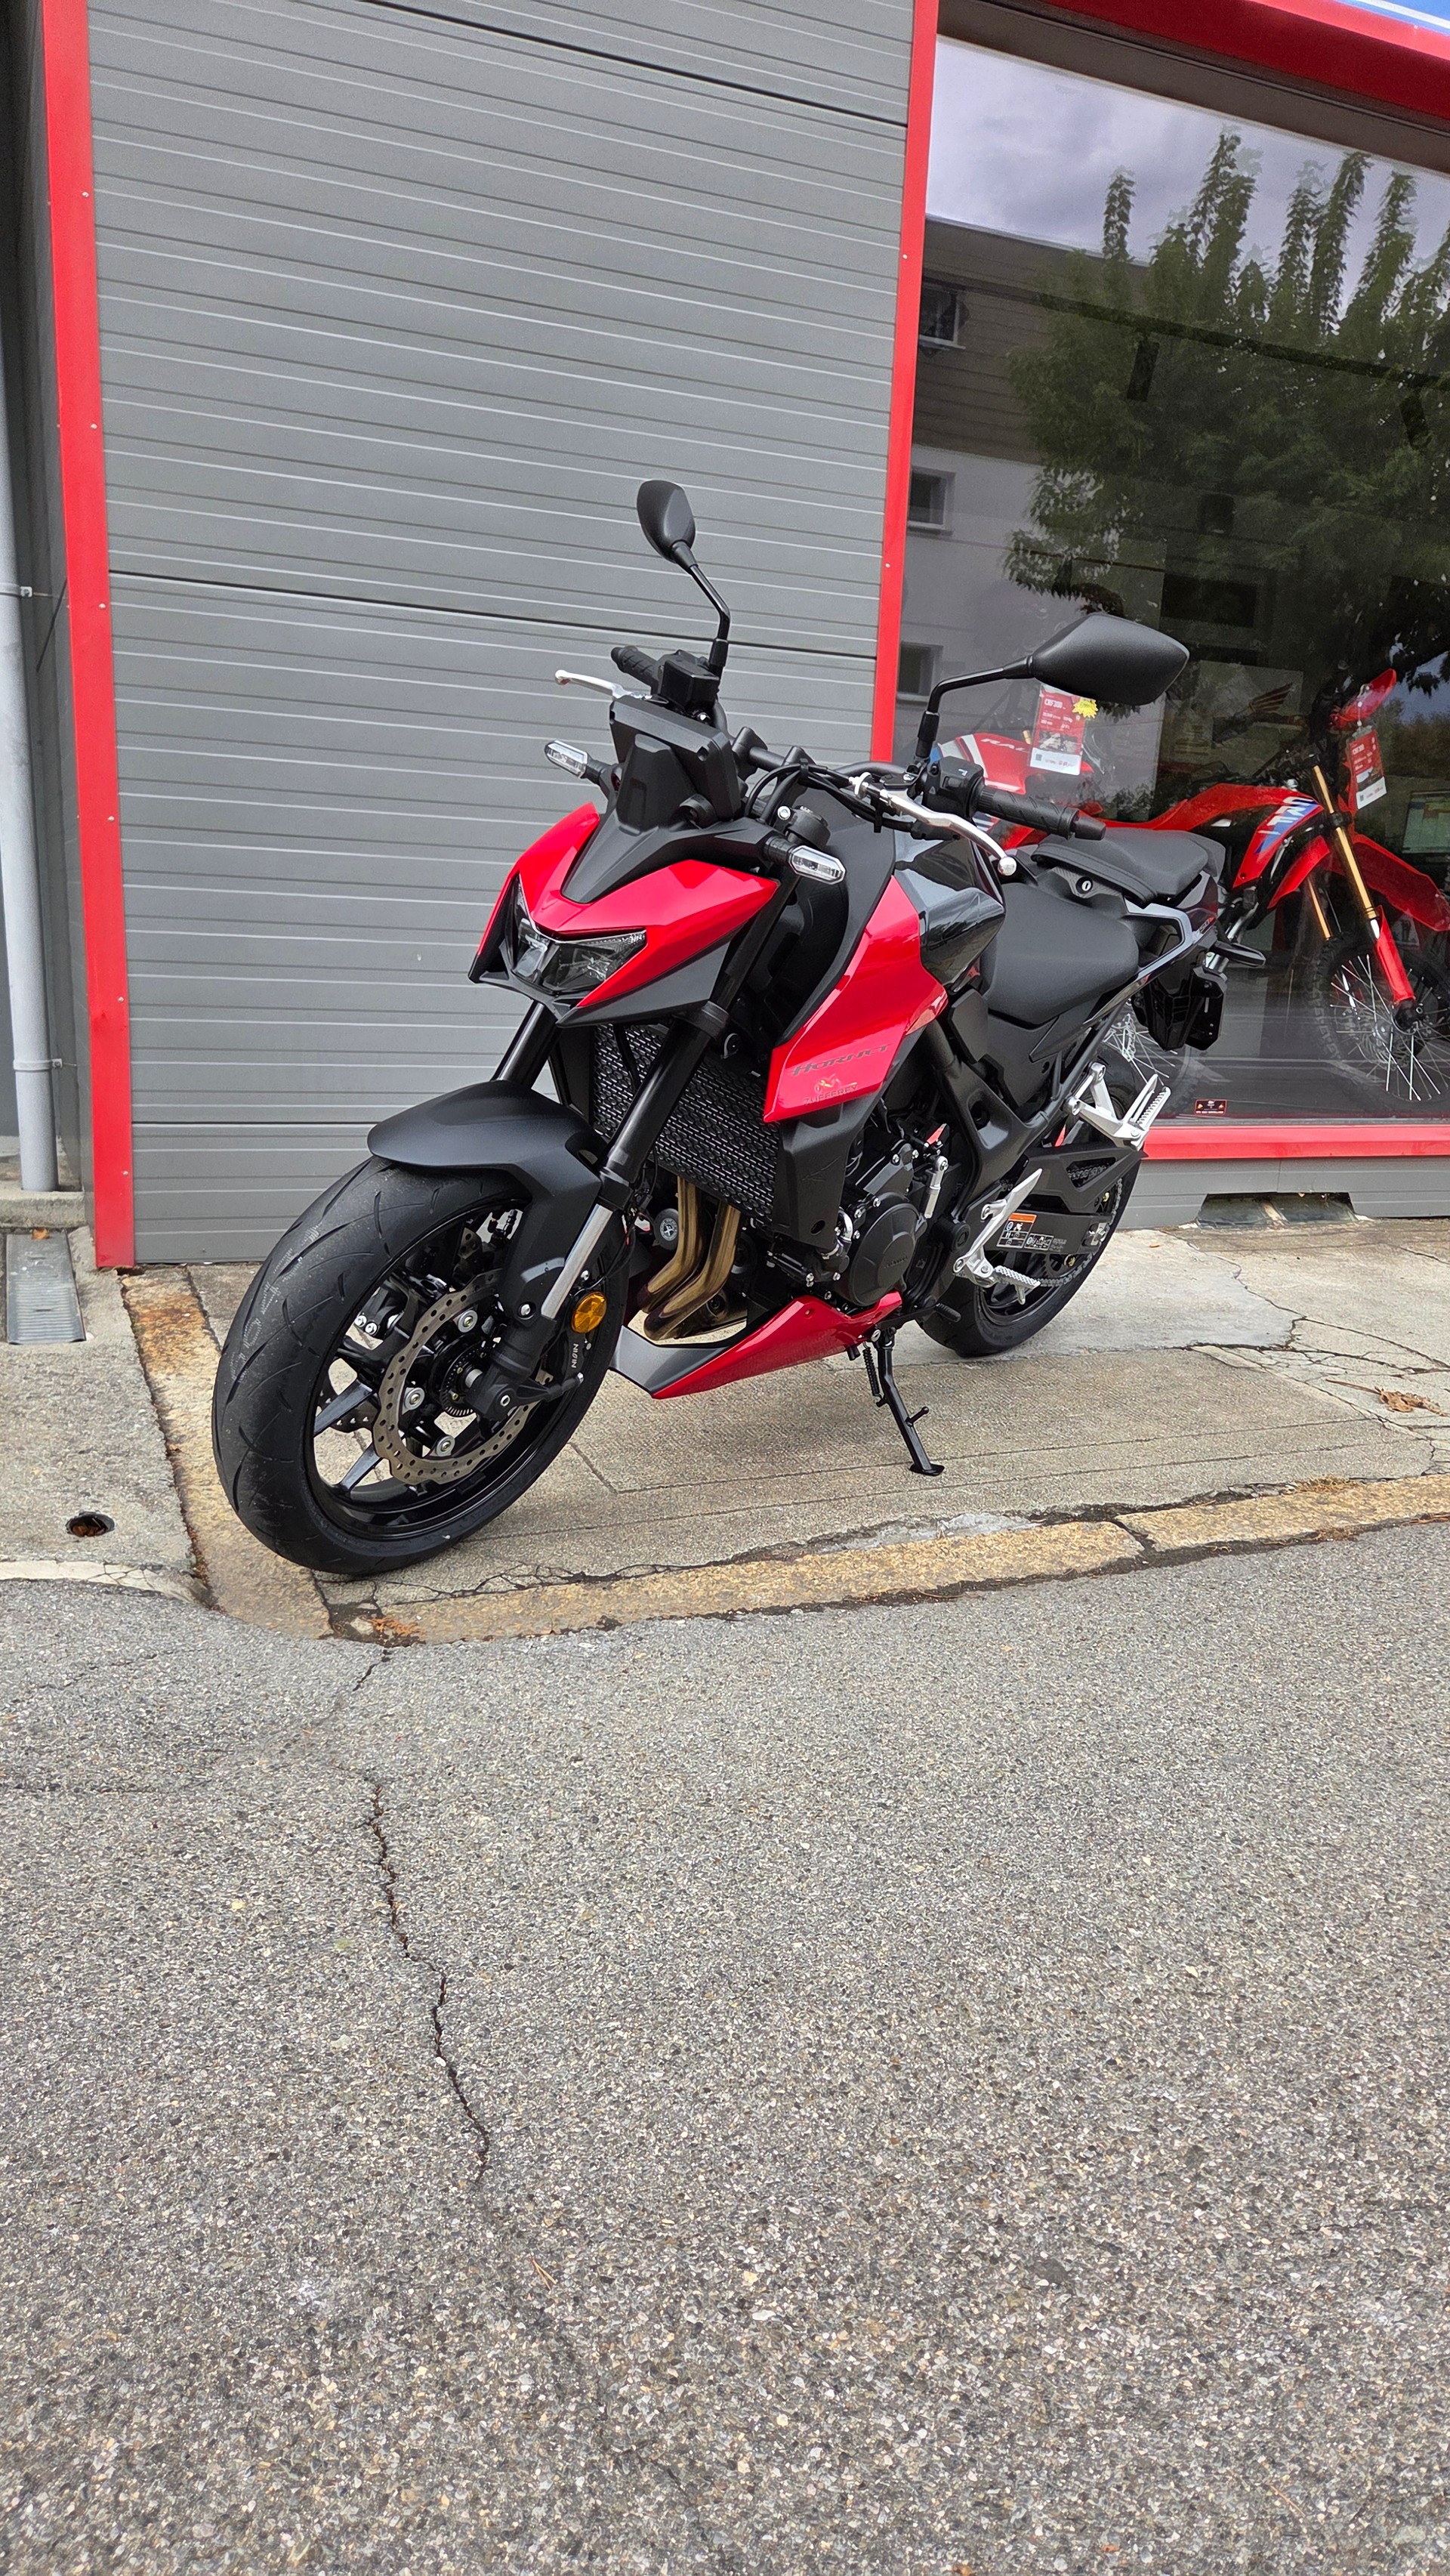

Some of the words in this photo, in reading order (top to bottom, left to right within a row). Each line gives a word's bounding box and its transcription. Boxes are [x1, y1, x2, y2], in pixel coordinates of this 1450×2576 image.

[981, 738, 1029, 754] RAL
[791, 1045, 890, 1076] HORNET
[804, 1084, 858, 1106] ZUFFEREY
